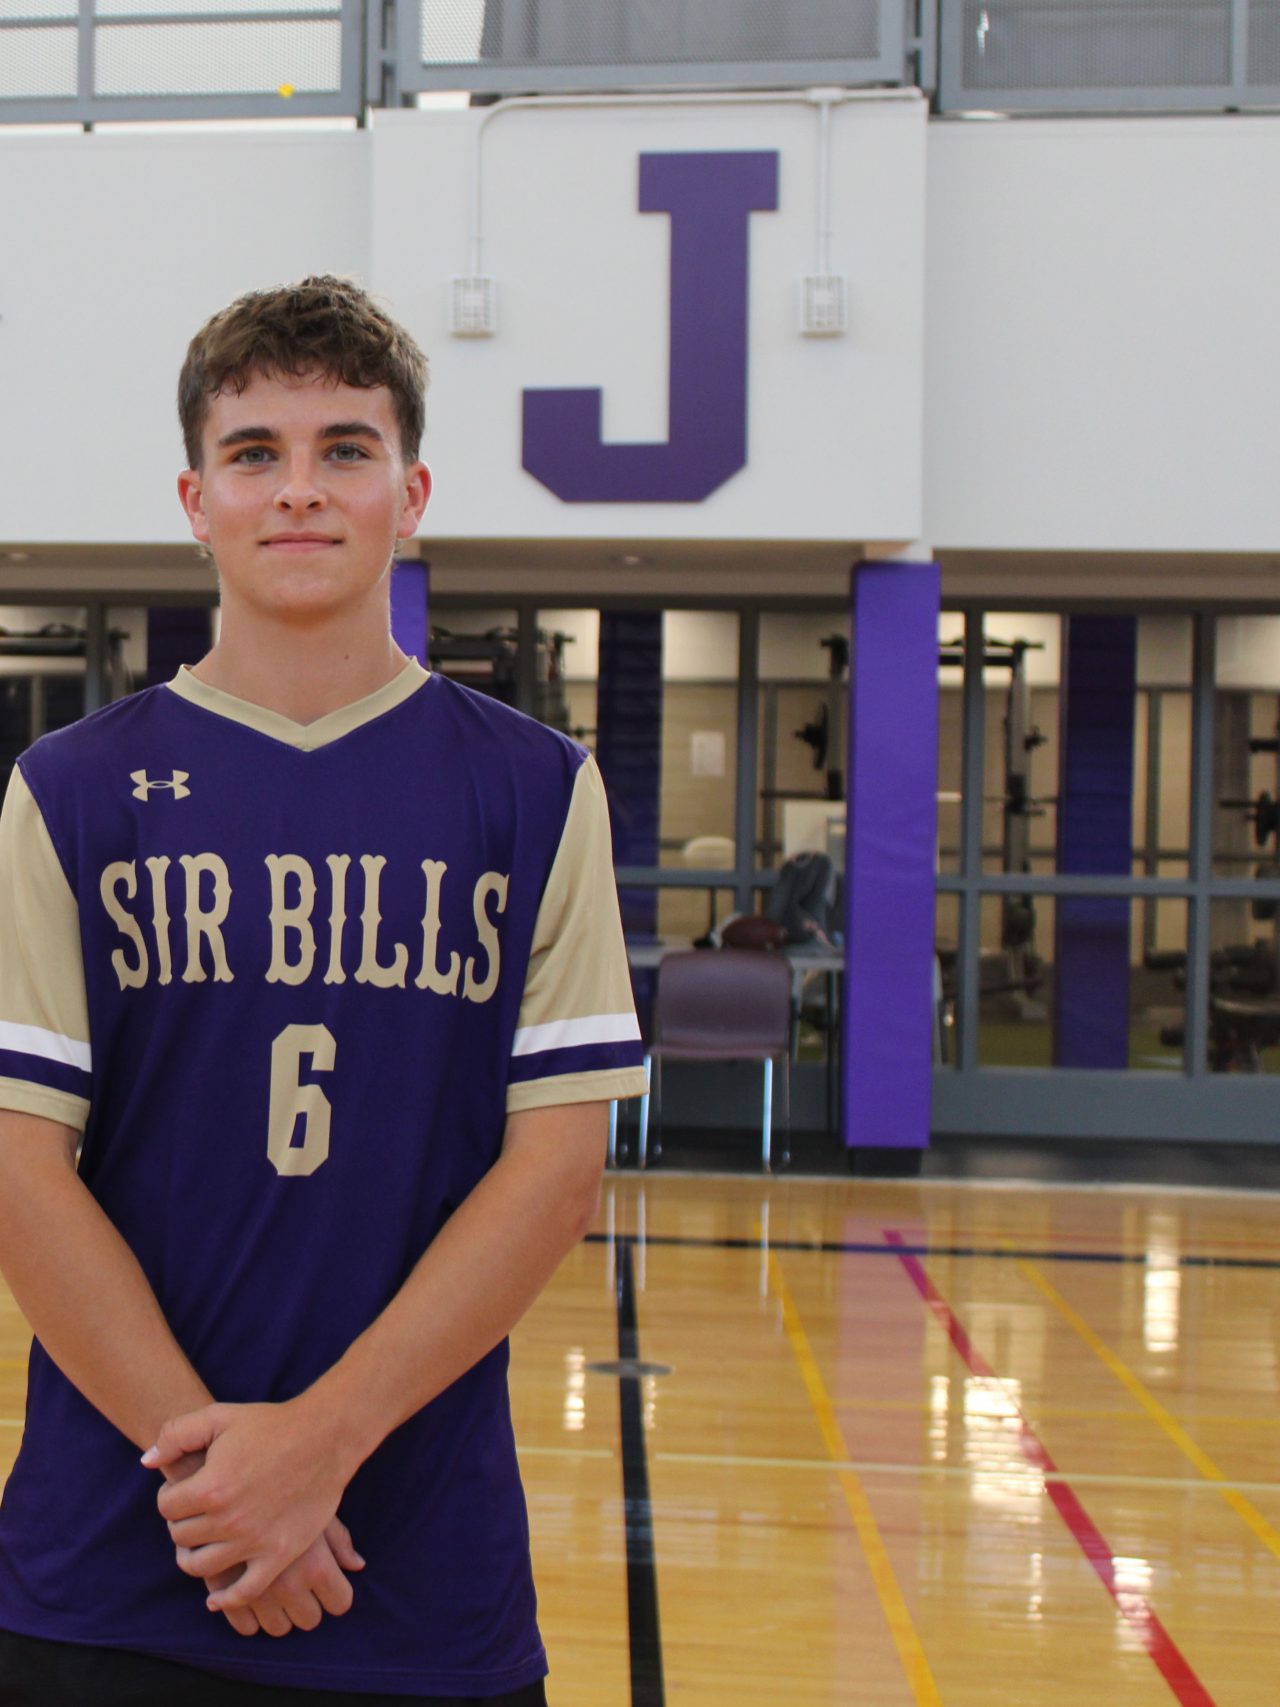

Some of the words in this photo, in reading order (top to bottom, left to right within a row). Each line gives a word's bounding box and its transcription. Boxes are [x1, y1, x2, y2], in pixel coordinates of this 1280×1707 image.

[521, 150, 780, 503] J
[100, 853, 234, 991] SIR
[265, 854, 510, 1004] BILLS
[266, 1023, 337, 1177] 6
